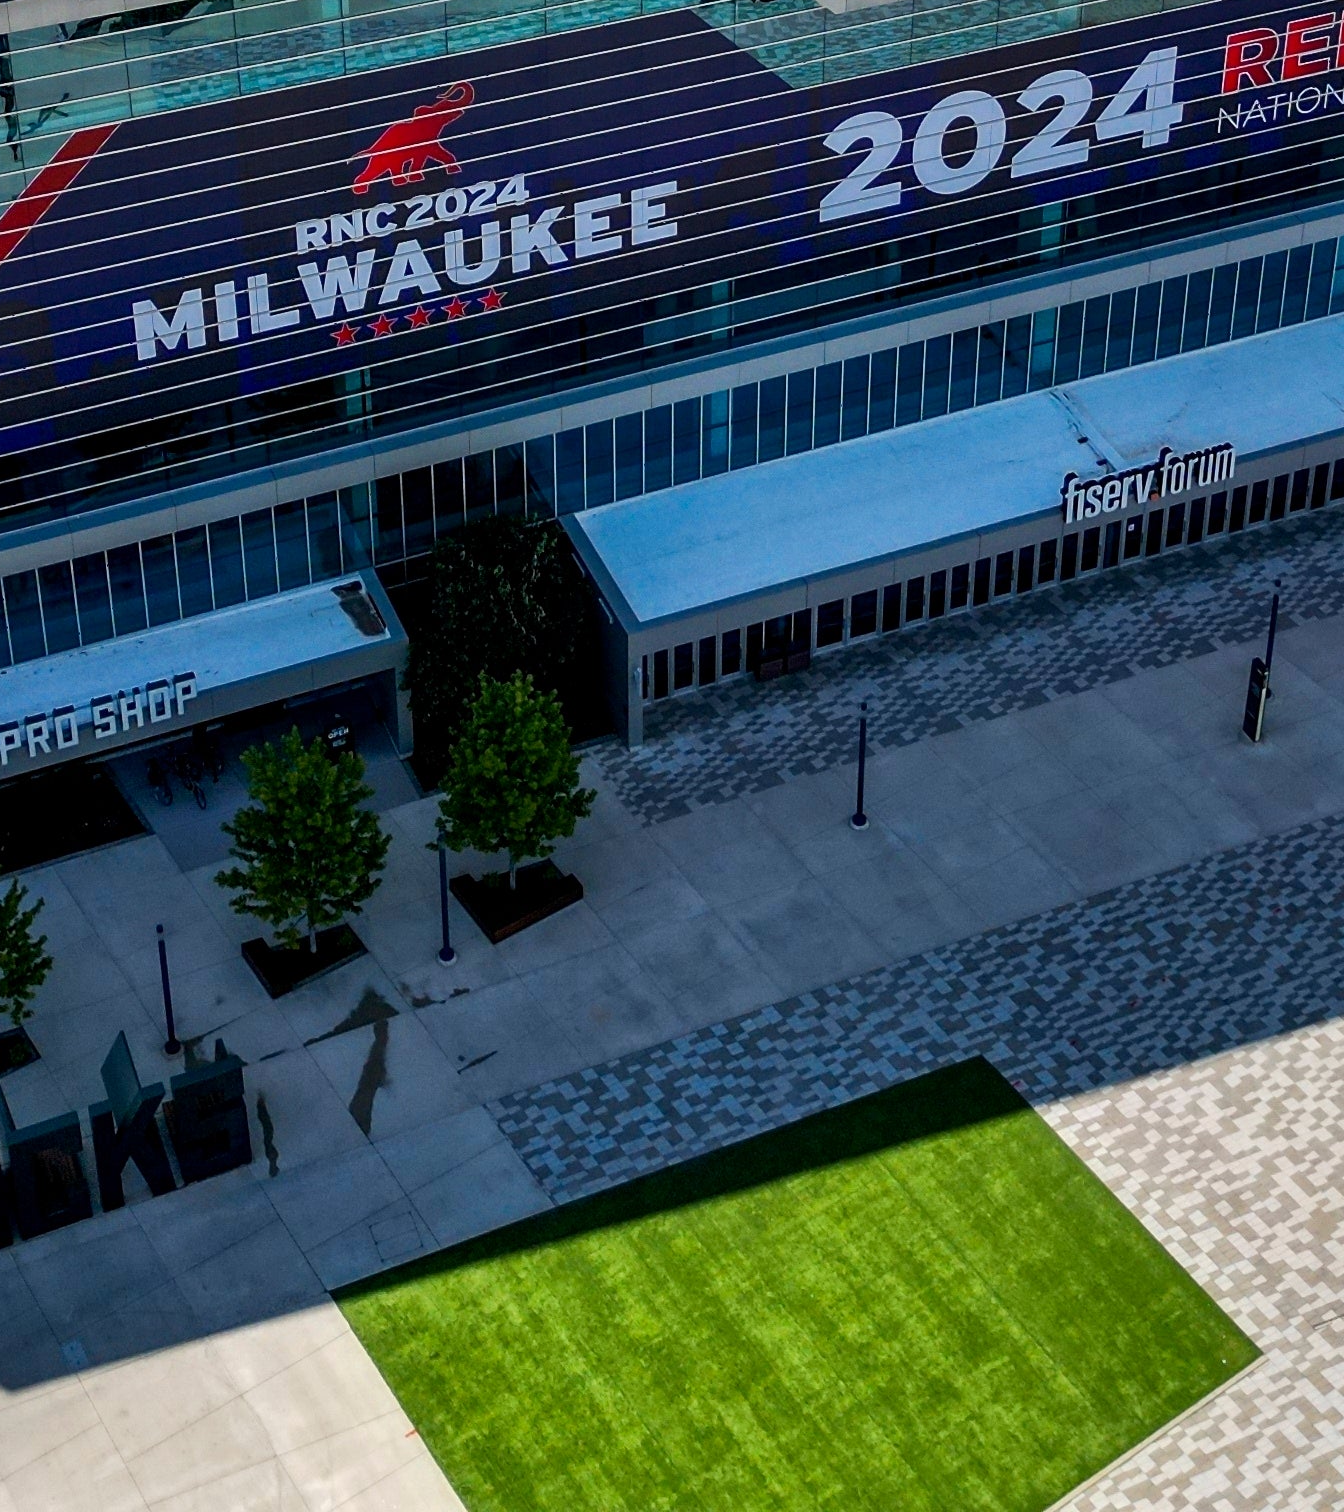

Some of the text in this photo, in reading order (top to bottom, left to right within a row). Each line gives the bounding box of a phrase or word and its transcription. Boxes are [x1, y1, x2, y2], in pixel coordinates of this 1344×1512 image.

[817, 45, 1185, 222] 2024
[294, 173, 530, 255] RNC 2024
[131, 179, 679, 361] MILWAUKEE
[93, 675, 198, 740] SHOP
[327, 727, 349, 740] OPEN
